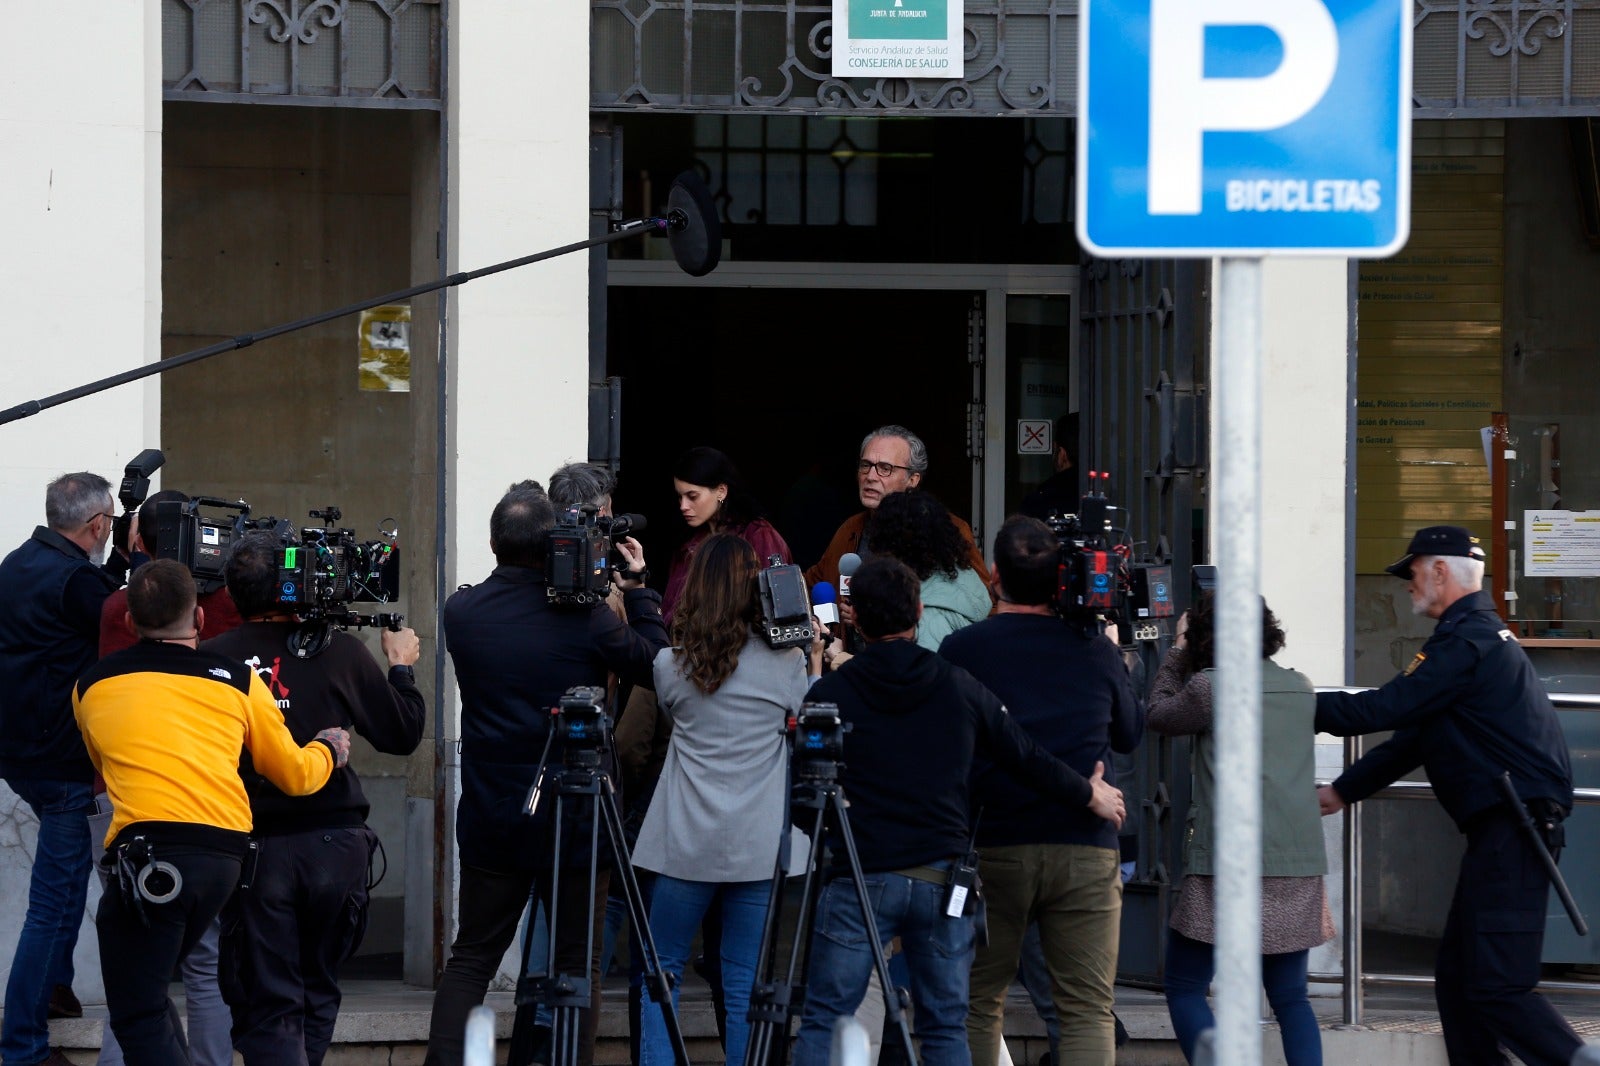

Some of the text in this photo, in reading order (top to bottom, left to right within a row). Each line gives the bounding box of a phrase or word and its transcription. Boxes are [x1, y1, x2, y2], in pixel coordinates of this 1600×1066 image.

[848, 45, 948, 55] Servicio Andaluz de Salud
[848, 56, 949, 69] CONSEJERÍA DE SALUD
[1148, 0, 1338, 215] P
[1225, 179, 1381, 212] BICICLETAS
[1357, 417, 1425, 426] ación de Pensiones
[1365, 435, 1393, 443] General
